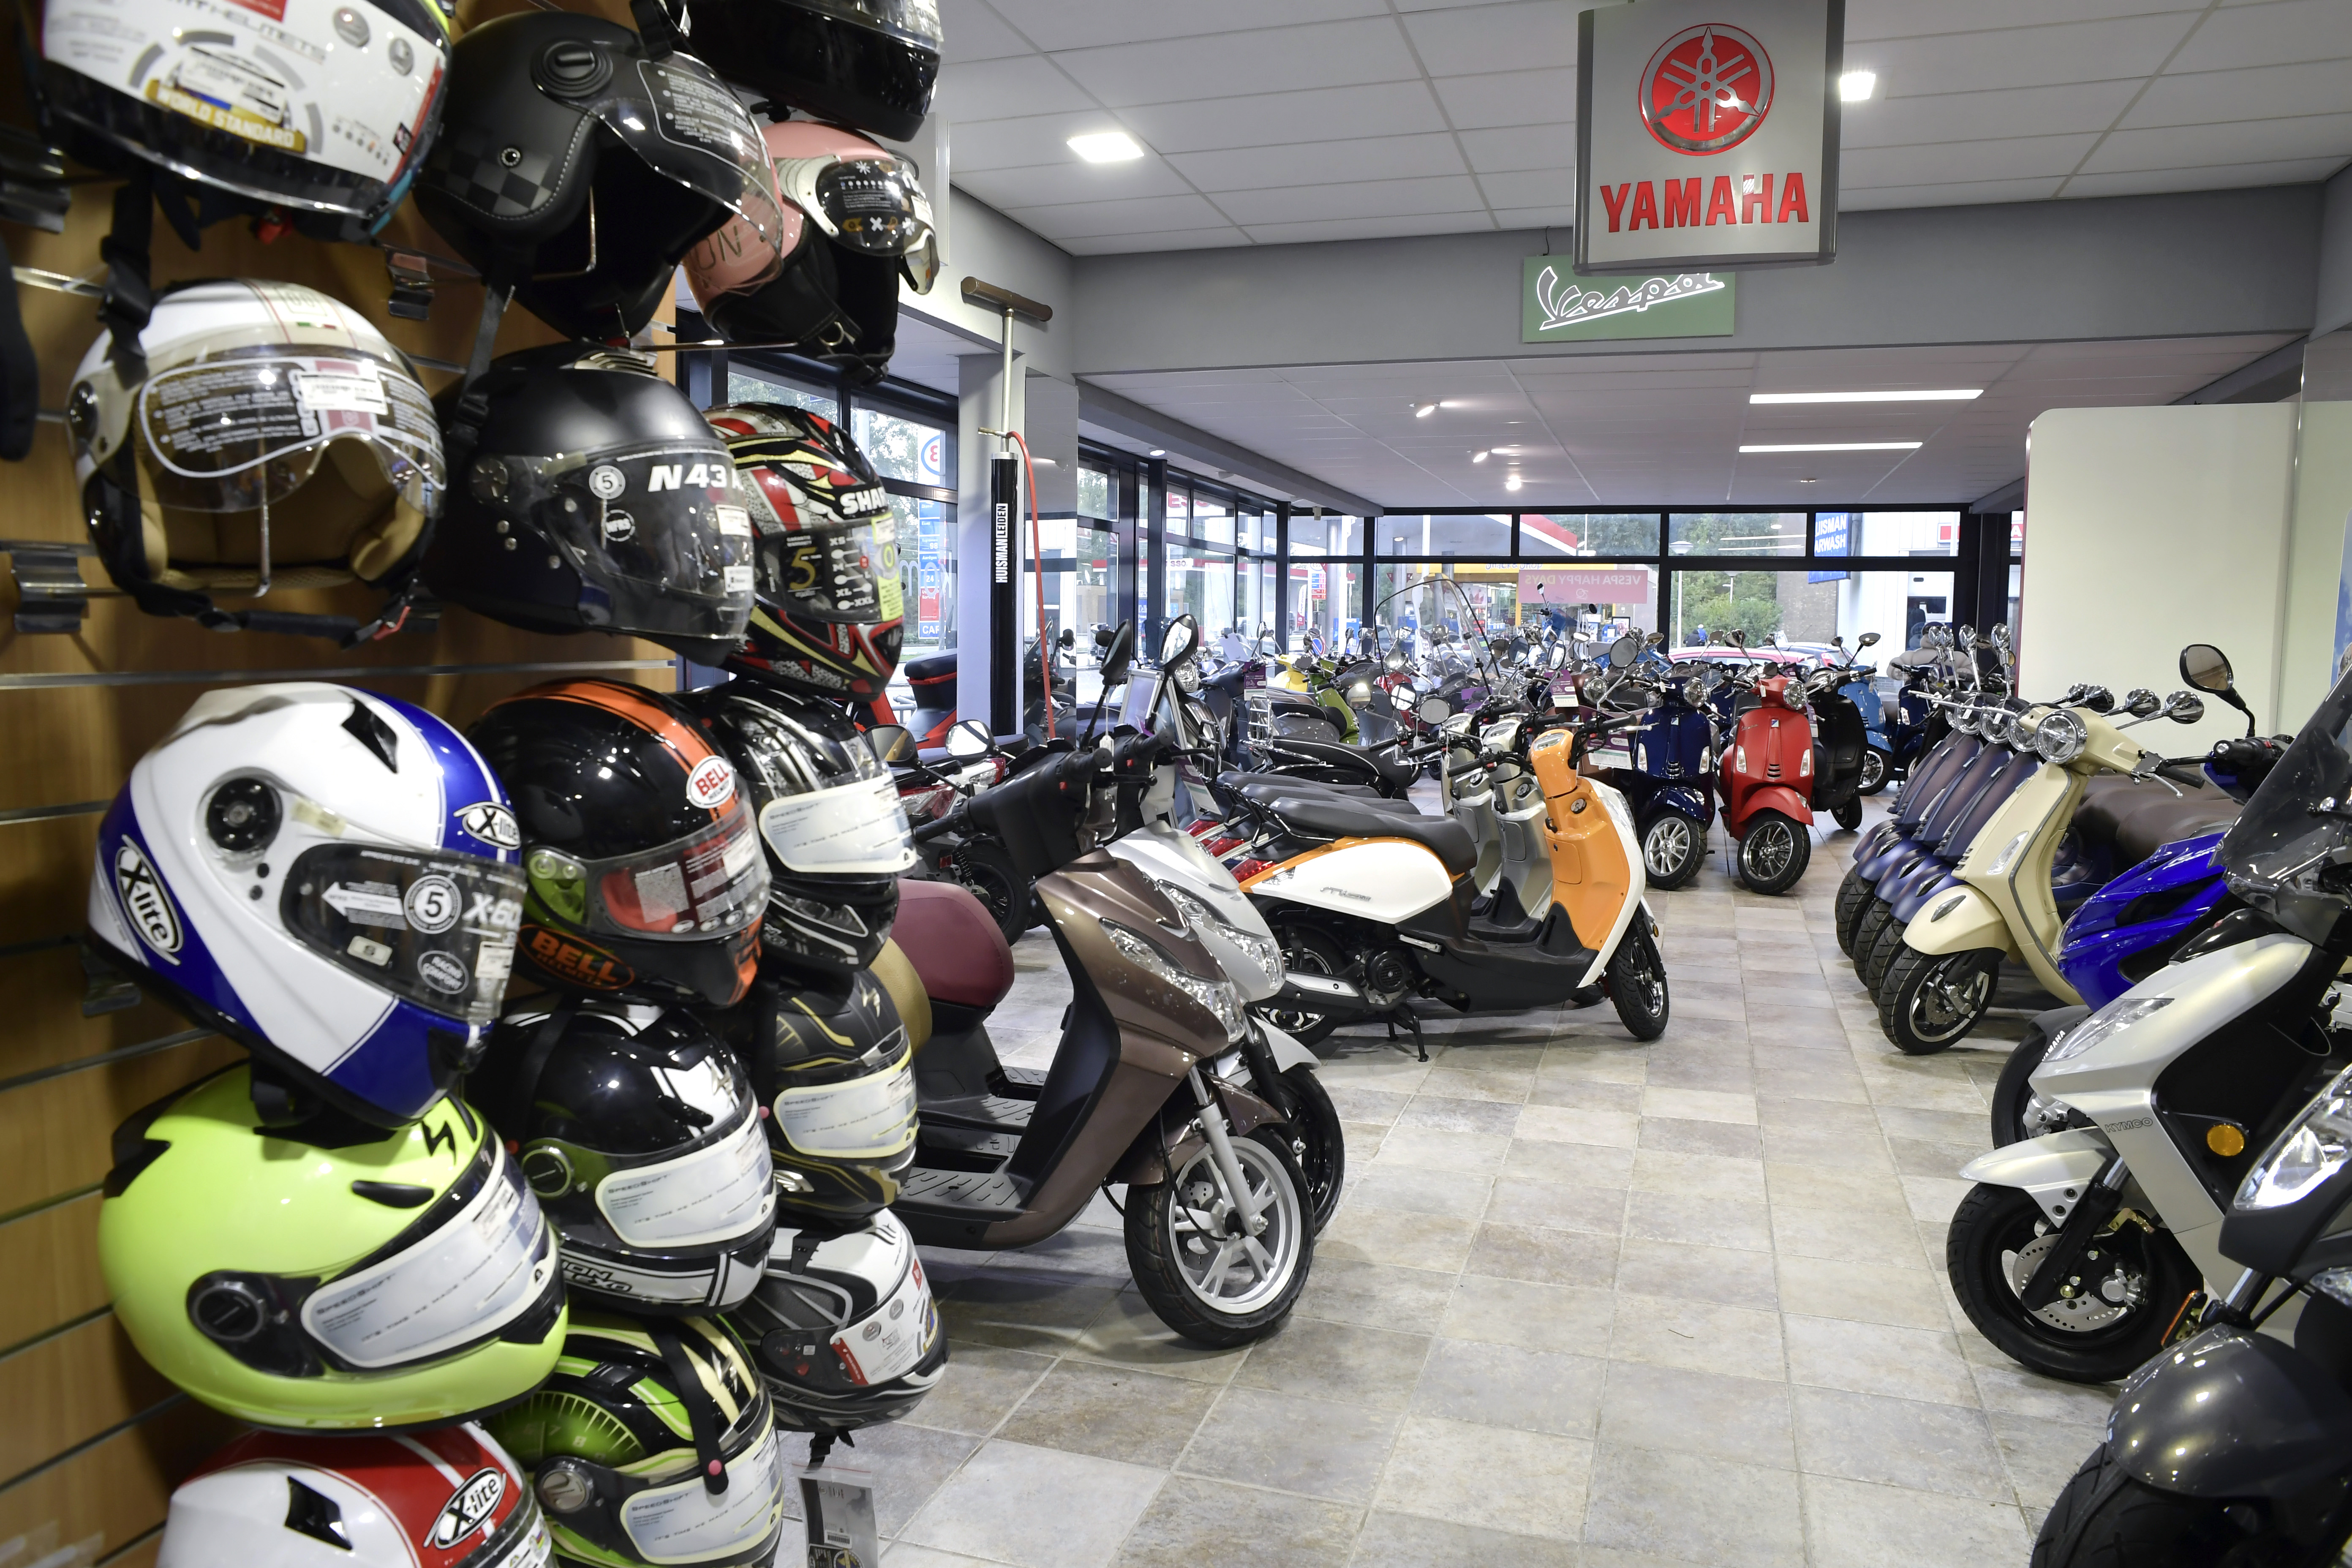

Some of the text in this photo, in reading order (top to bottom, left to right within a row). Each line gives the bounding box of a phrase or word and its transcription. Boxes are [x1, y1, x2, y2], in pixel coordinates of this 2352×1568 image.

[155, 86, 210, 120] WORLD
[214, 109, 295, 148] STANDARD
[1600, 172, 1809, 233] YAMAHA
[1536, 266, 1725, 331] Vespa
[602, 475, 612, 489] 5
[996, 506, 1008, 583] HUISMAN LEIDEN
[1814, 534, 1846, 553] ARWASH
[1815, 514, 1847, 537] UISMAN
[789, 547, 817, 590] 5
[695, 763, 729, 796] BELL
[476, 808, 520, 842] X-lite
[119, 860, 168, 942] X-lite
[425, 891, 444, 917] 5
[531, 931, 618, 983] BELL
[2104, 1117, 2153, 1133] KYMCO
[446, 1477, 500, 1544] X-lite
